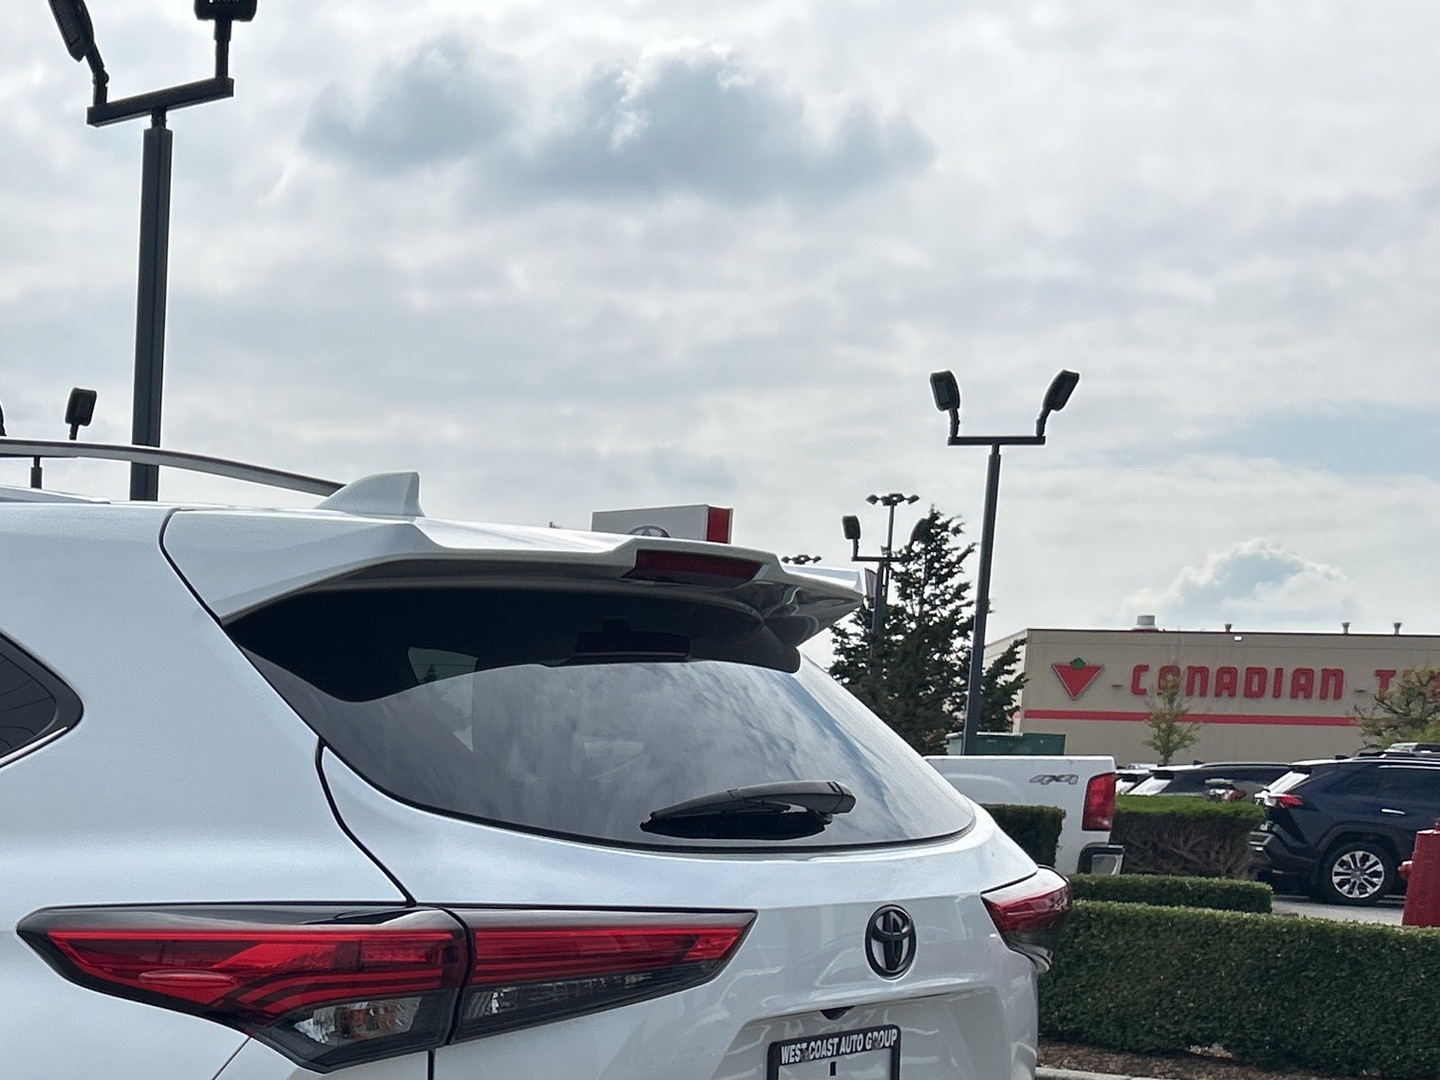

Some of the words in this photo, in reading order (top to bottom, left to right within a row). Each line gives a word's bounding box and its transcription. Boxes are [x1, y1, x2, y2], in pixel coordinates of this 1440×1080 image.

[1131, 664, 1345, 700] CANADIAN
[808, 1037, 840, 1060] COAST
[839, 1032, 864, 1055] AUTO
